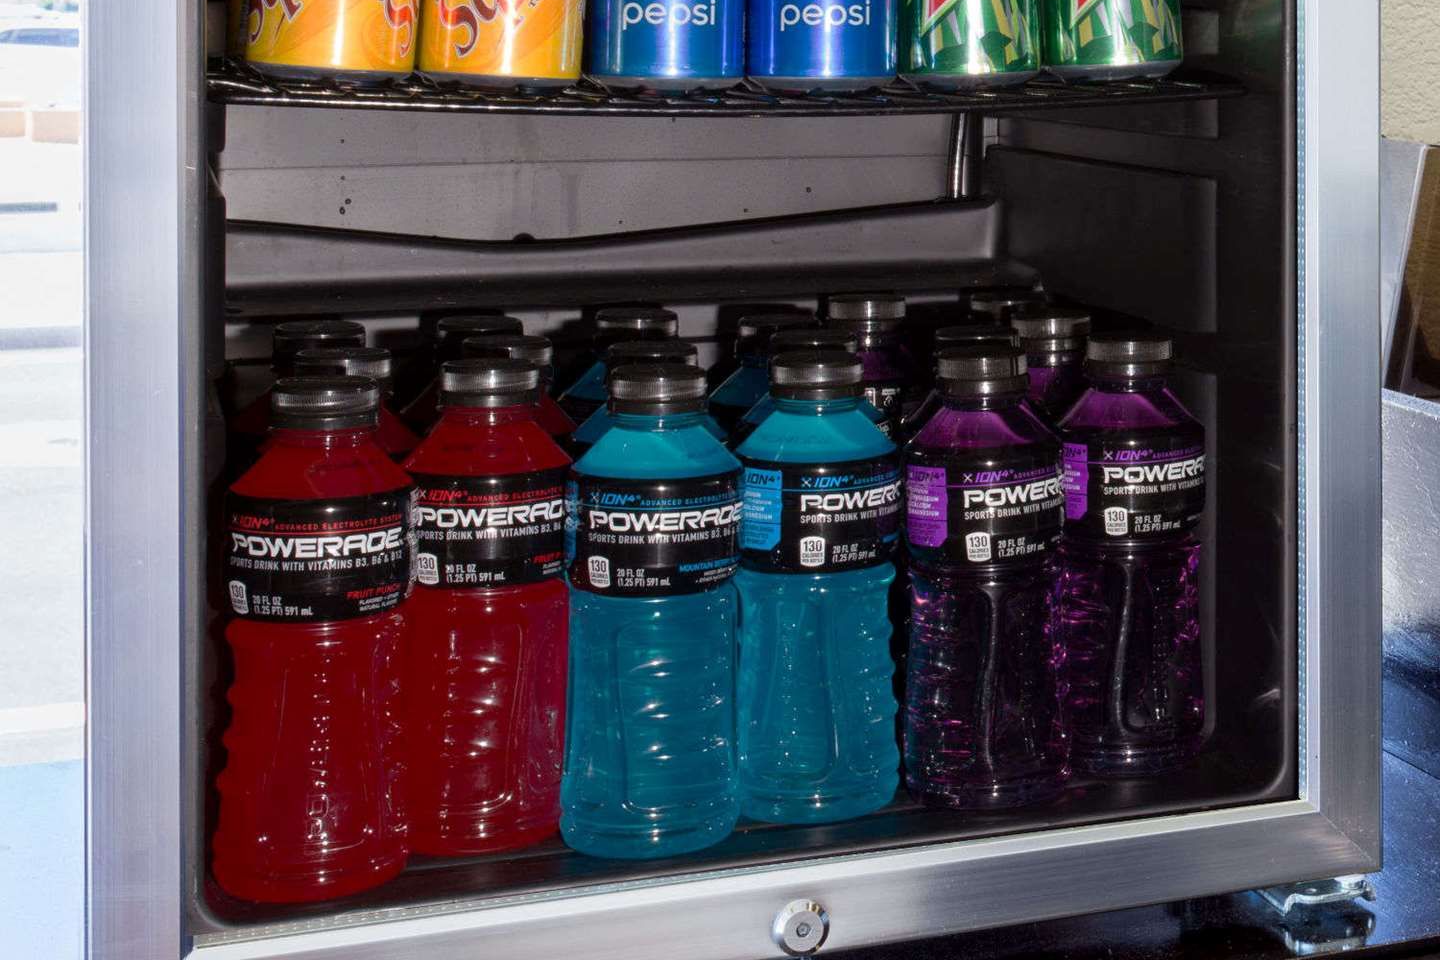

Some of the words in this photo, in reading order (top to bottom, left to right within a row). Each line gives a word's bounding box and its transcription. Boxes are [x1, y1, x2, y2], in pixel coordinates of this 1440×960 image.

[779, 0, 871, 32] pepsi
[1103, 456, 1206, 483] POWERA
[963, 476, 1064, 508] POWER
[1104, 486, 1133, 496] SPORTS
[1135, 486, 1158, 494] DRINK
[1161, 483, 1177, 492] WITH
[800, 480, 901, 512] POWER
[415, 499, 564, 528] POWERAD
[588, 501, 744, 532] POWERADE
[800, 514, 832, 524] SPORTS
[834, 513, 858, 523] DRINK
[860, 511, 878, 520] WITH
[964, 510, 995, 520] SPORTS
[997, 508, 1021, 518] DRINK
[1023, 505, 1040, 514] WITH
[1107, 511, 1125, 522] 130
[415, 530, 444, 540] SPORTS
[446, 529, 473, 540] DRINK
[476, 528, 498, 539] WITH
[500, 525, 539, 537] VITAMINS
[588, 533, 616, 544] SPORTS
[618, 534, 645, 544] DRINK
[647, 533, 670, 544] WITH
[672, 530, 709, 543] VITAMINS
[231, 527, 403, 558] POWERADE
[803, 540, 822, 552] 130
[969, 535, 988, 547] 130
[254, 559, 279, 570] DRINK
[282, 561, 305, 571] WITH
[308, 559, 353, 571] VITAMINS
[418, 557, 434, 569] 130
[456, 564, 464, 573] FL
[466, 564, 477, 573] OZ
[590, 560, 607, 572] 130
[479, 572, 493, 581] 591
[616, 568, 625, 577] 20
[626, 568, 635, 577] FL
[636, 568, 645, 577] OZ
[617, 578, 633, 587] (1.25
[646, 578, 659, 587] 591
[263, 595, 271, 605] FL
[272, 596, 282, 605] OZ
[285, 606, 299, 615] 591
